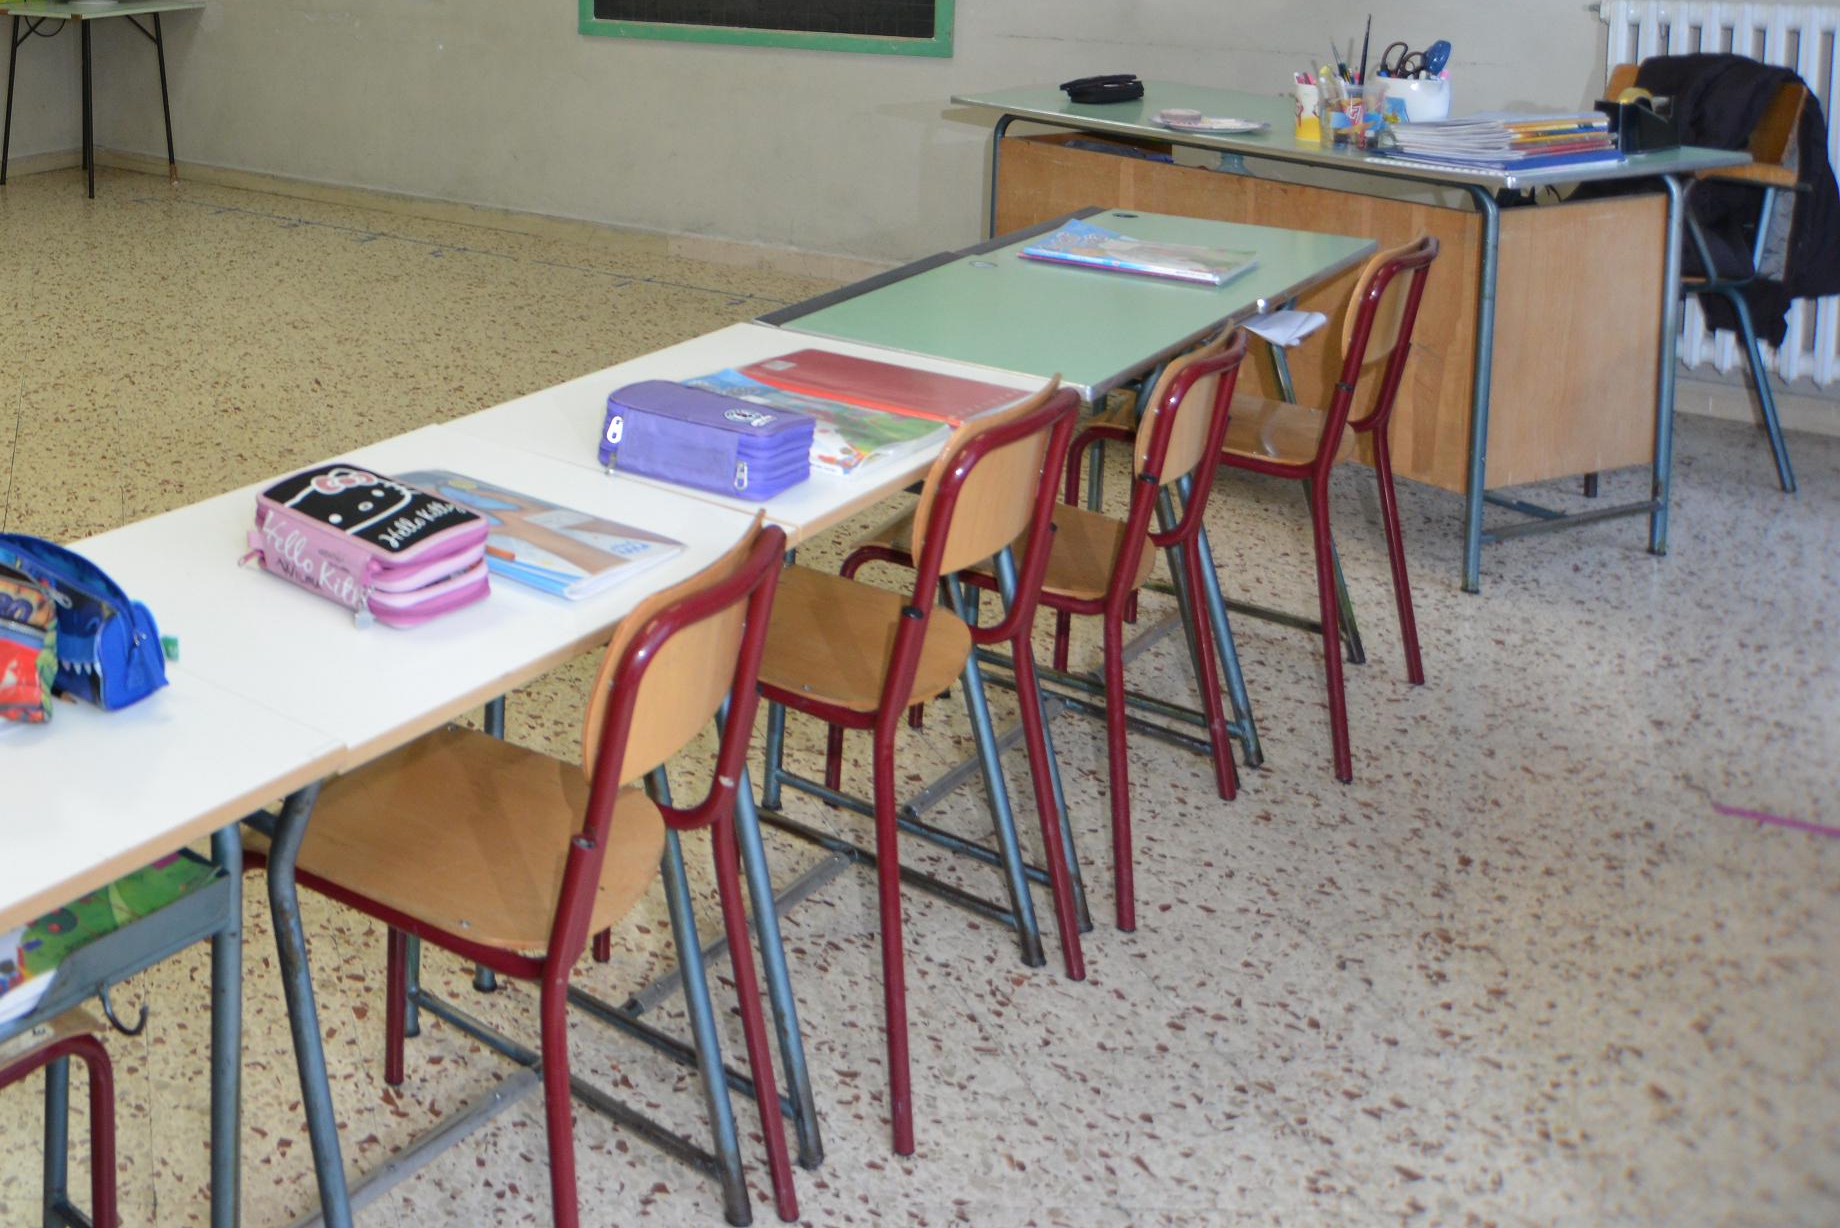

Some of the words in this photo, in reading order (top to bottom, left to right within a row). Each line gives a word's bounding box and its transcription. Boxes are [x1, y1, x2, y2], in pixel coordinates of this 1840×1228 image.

[263, 510, 313, 573] Hello
[378, 517, 426, 549] Hello
[416, 501, 467, 523] Kitty
